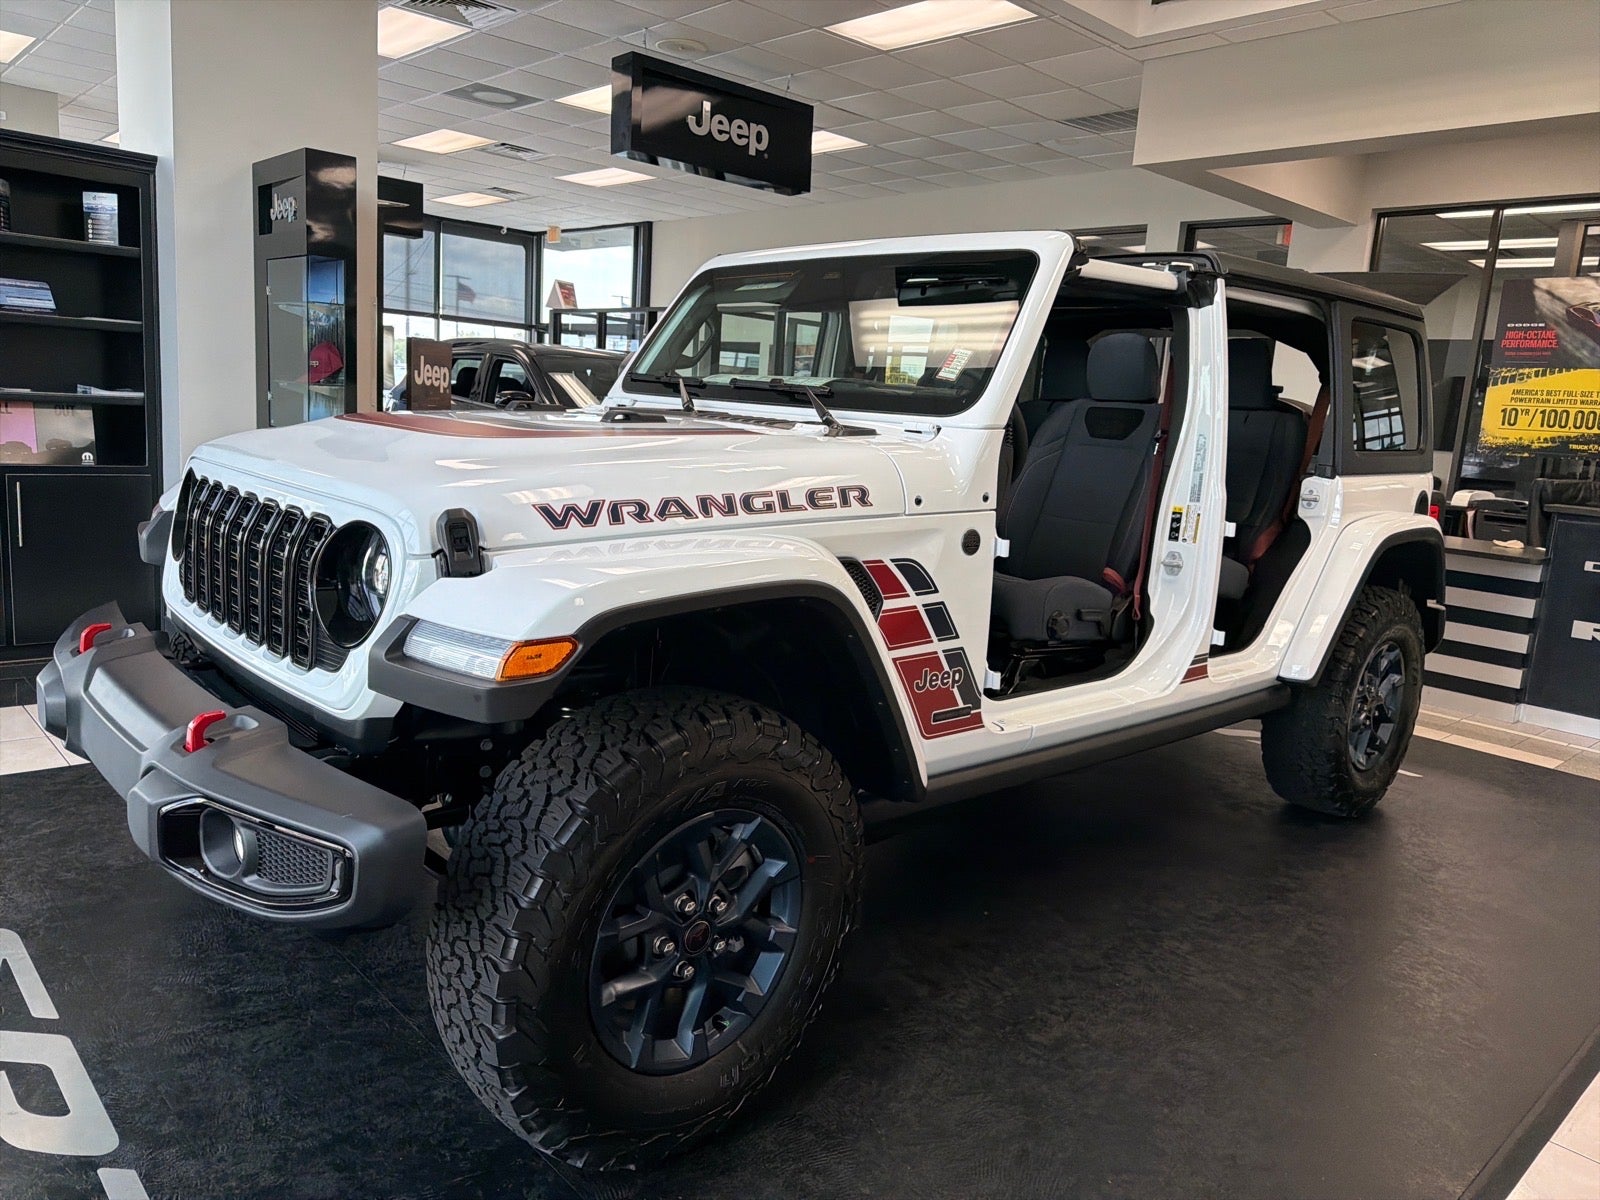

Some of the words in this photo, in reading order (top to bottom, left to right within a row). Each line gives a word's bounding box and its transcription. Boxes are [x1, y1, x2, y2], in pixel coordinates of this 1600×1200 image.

[687, 100, 770, 156] Jeep
[270, 193, 297, 222] Jeep
[1505, 331, 1556, 339] HIGH-OCTANE
[414, 355, 450, 393] Jeep
[1545, 389, 1561, 397] BEST
[1562, 390, 1594, 398] FULL-SIZE
[1552, 397, 1577, 405] LIMITED
[532, 485, 873, 530] WRANGLER
[914, 666, 964, 693] Jeep
